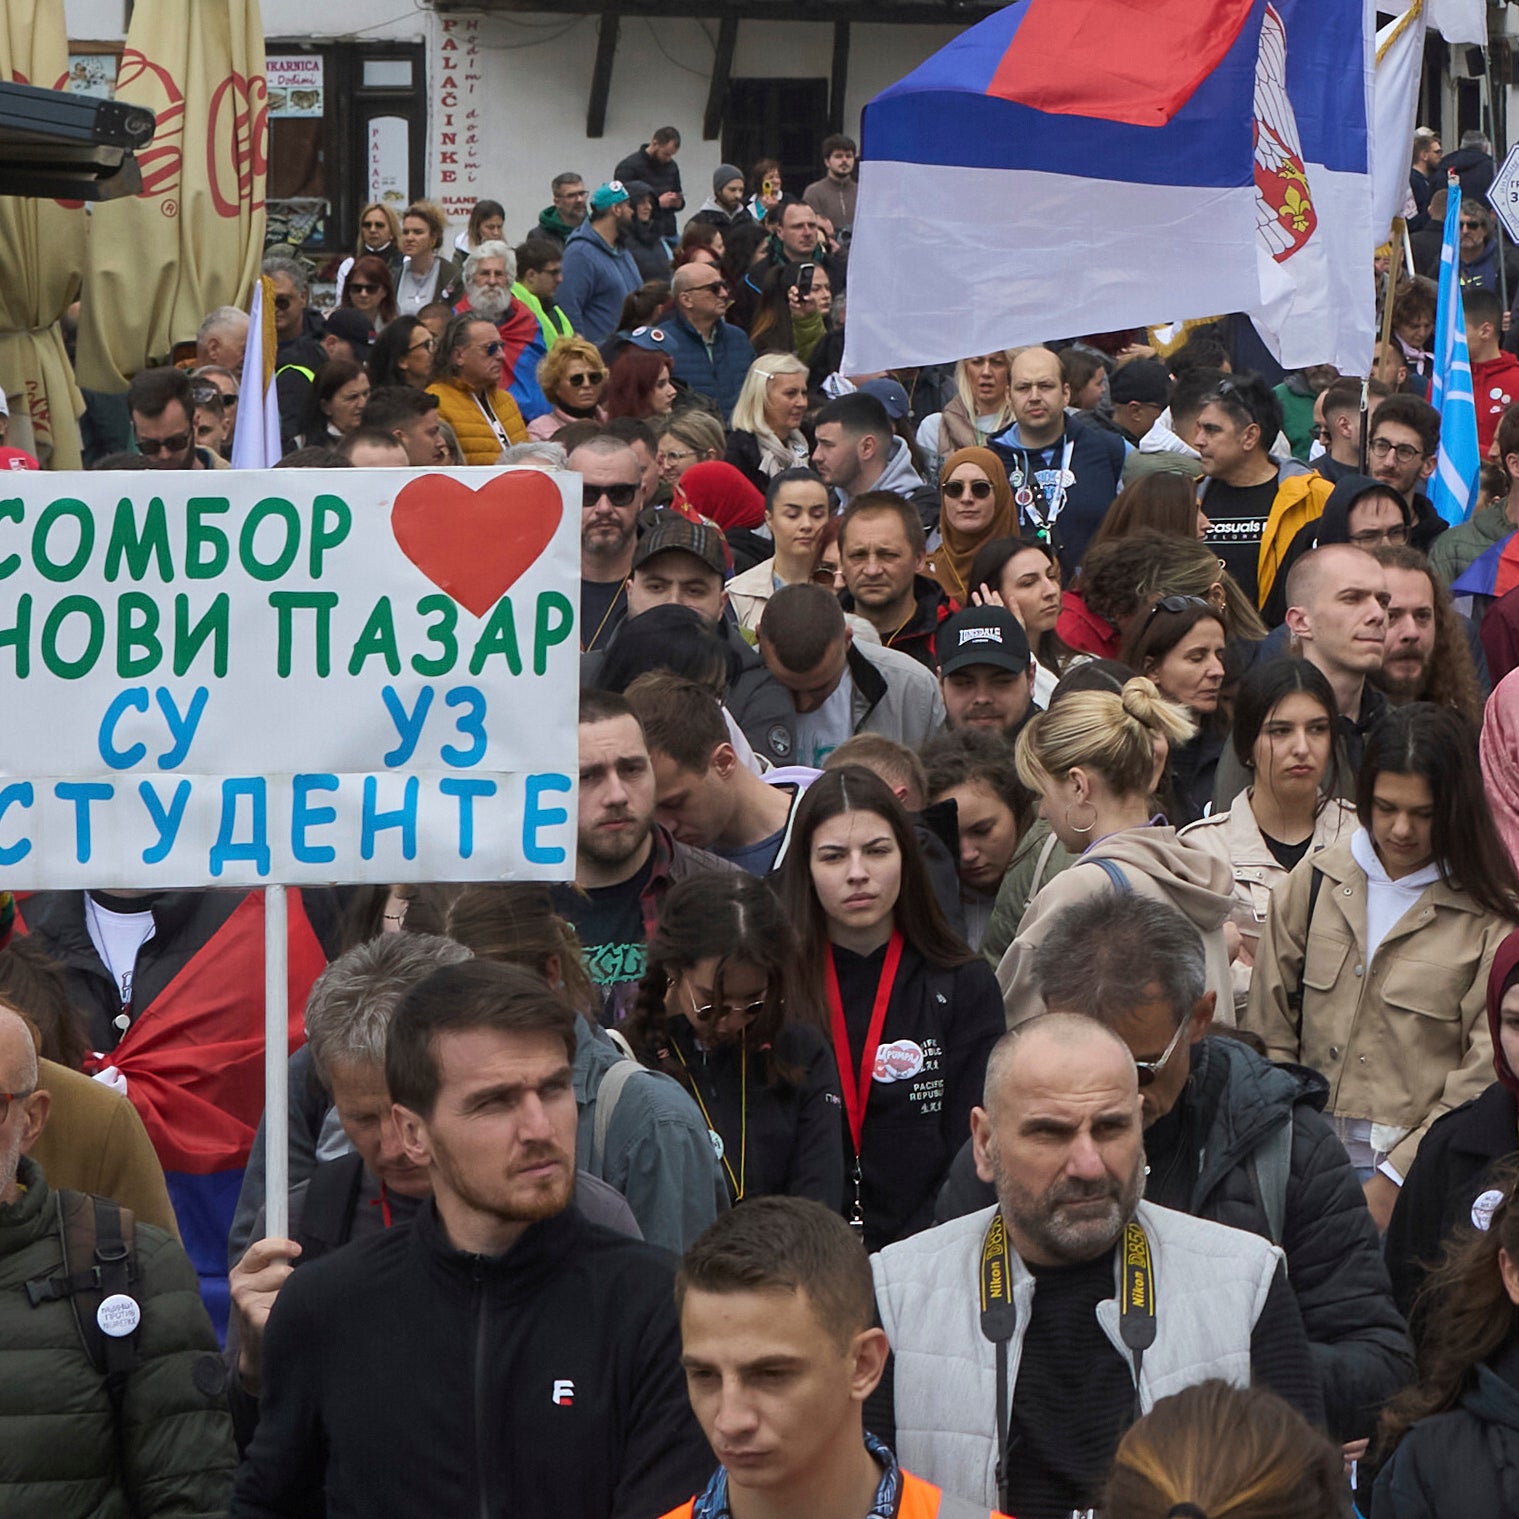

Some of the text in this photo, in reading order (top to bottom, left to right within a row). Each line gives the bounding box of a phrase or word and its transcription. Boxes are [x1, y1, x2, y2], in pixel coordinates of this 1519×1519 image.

[440, 19, 458, 183] PALAČINKE
[371, 129, 379, 203] PALAČI
[268, 591, 574, 678] ПАЗАР
[98, 685, 487, 770] СУ УЗ
[0, 774, 572, 877] СТУДЕНТЕ
[989, 1261, 1002, 1299] Nikon
[1132, 1271, 1145, 1308] Nikon
